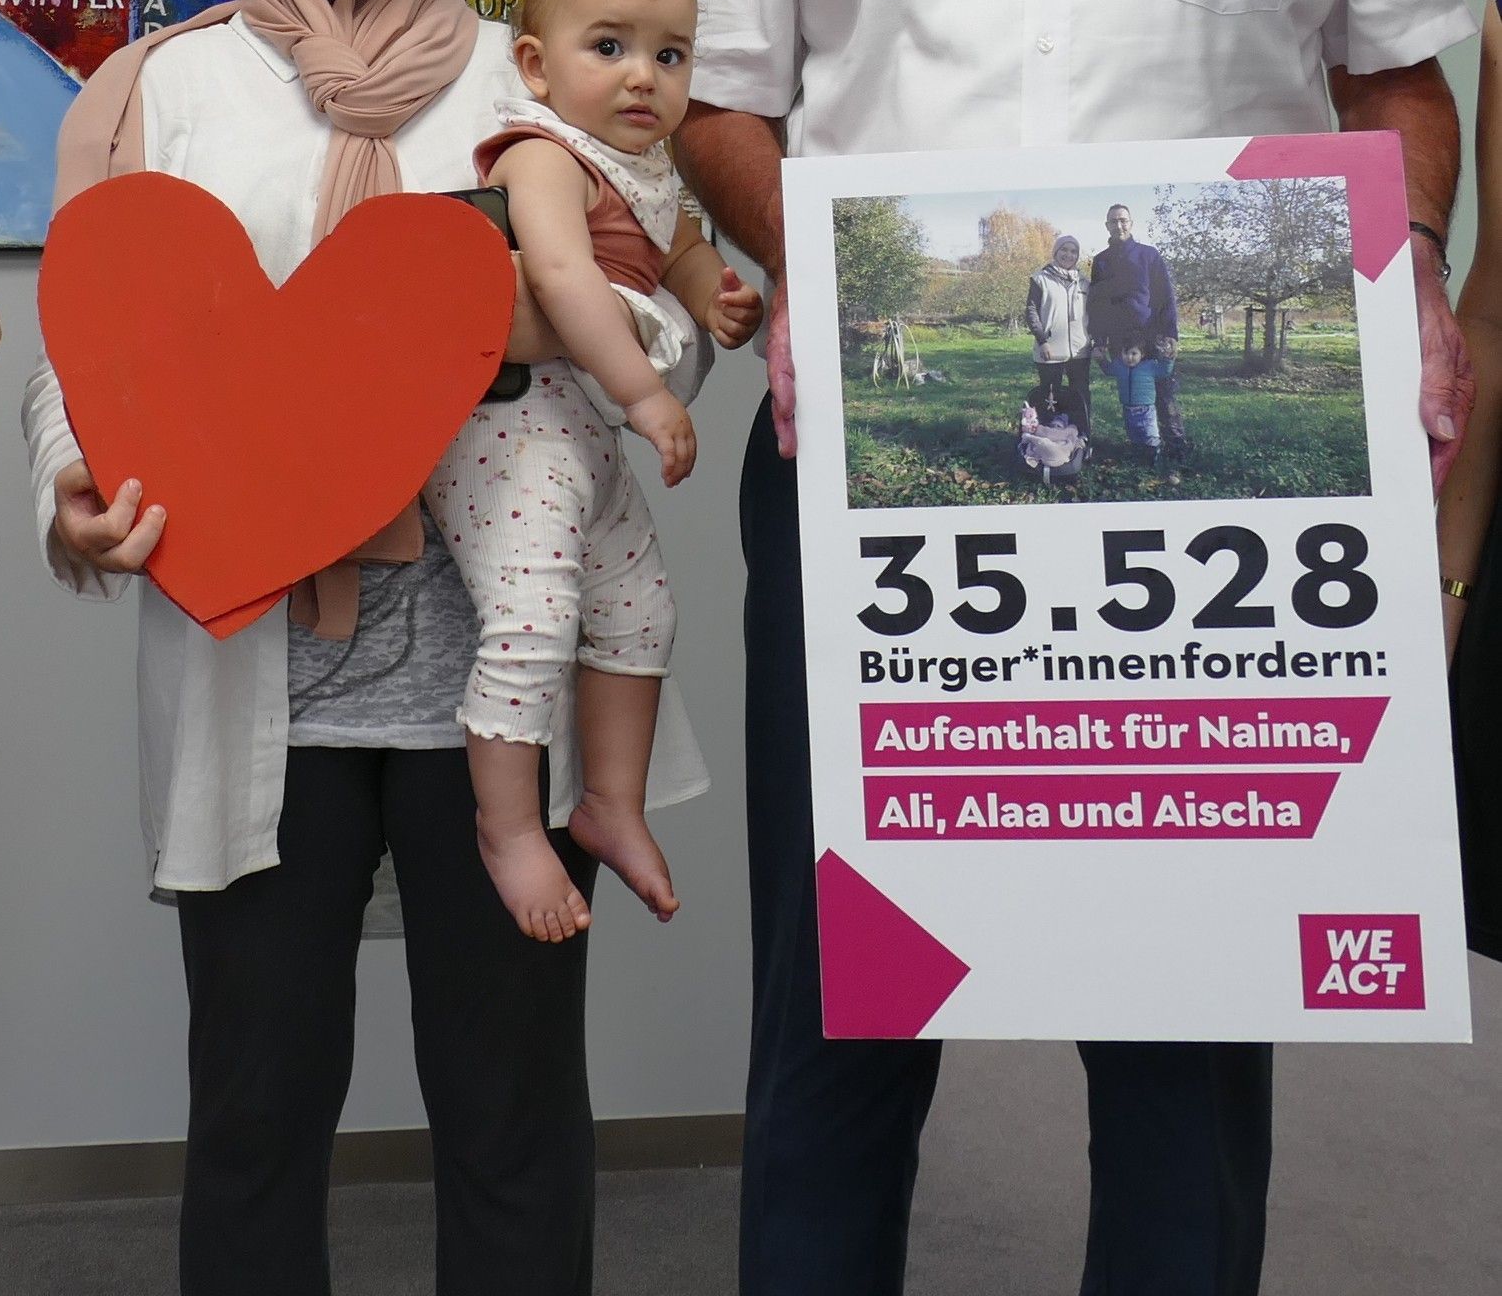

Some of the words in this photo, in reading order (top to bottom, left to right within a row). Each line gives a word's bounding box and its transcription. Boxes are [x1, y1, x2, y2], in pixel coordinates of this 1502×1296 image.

[856, 522, 1380, 636] 35.528
[874, 714, 1114, 752] Aufenthalt
[1121, 713, 1190, 750] für
[1199, 712, 1351, 755] Naima,
[878, 793, 947, 835] Ali,
[956, 793, 1050, 829] Alaa
[1060, 792, 1143, 828] und
[1153, 791, 1302, 828] Aischa
[1326, 929, 1393, 961] WE
